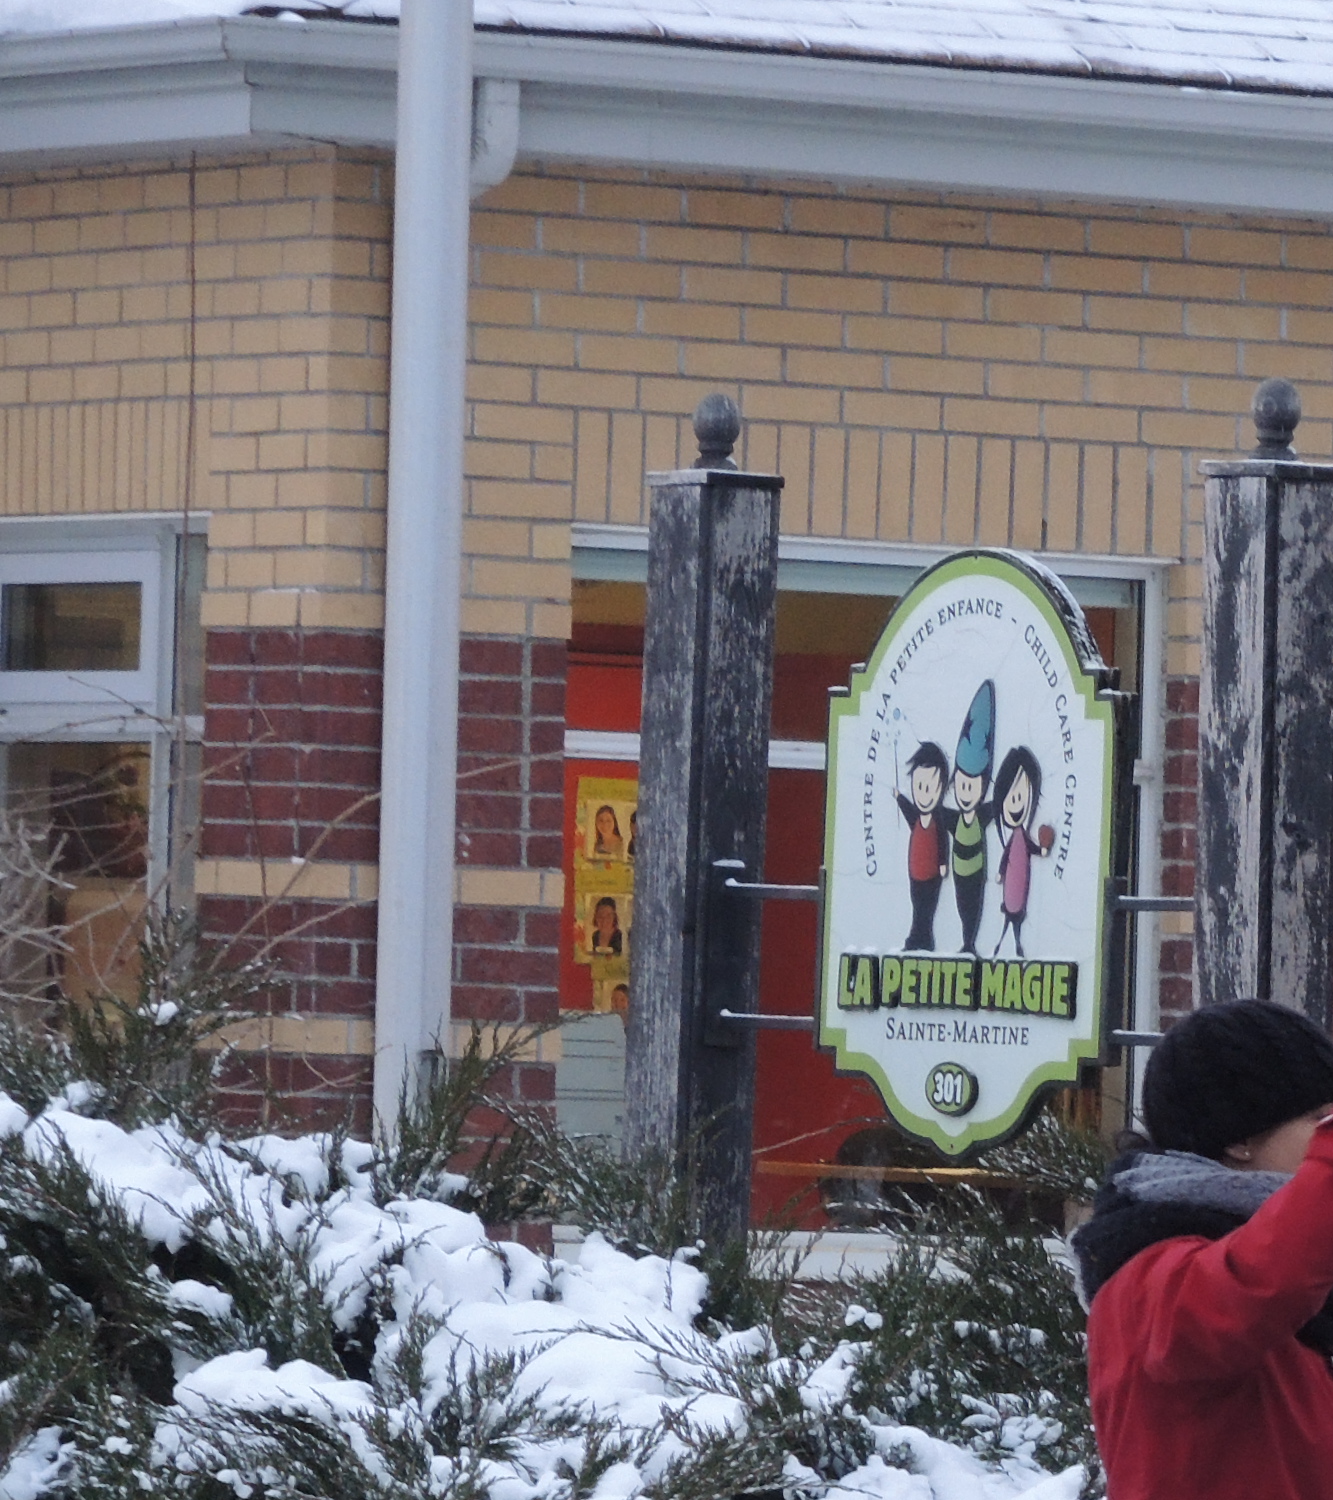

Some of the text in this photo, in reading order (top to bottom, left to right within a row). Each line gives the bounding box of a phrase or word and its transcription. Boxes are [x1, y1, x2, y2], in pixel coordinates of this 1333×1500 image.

[938, 598, 1004, 626] ENFANCE
[889, 620, 935, 686] PETITE
[1024, 624, 1058, 688] CHILD
[876, 692, 892, 721] LA
[1055, 694, 1074, 764] CARE
[868, 727, 881, 763] DE
[863, 772, 878, 877] CENTRE
[1053, 774, 1077, 880] CENTRE
[840, 955, 1071, 1016] LA PETITE MAGIE
[932, 1072, 964, 1105] 301
